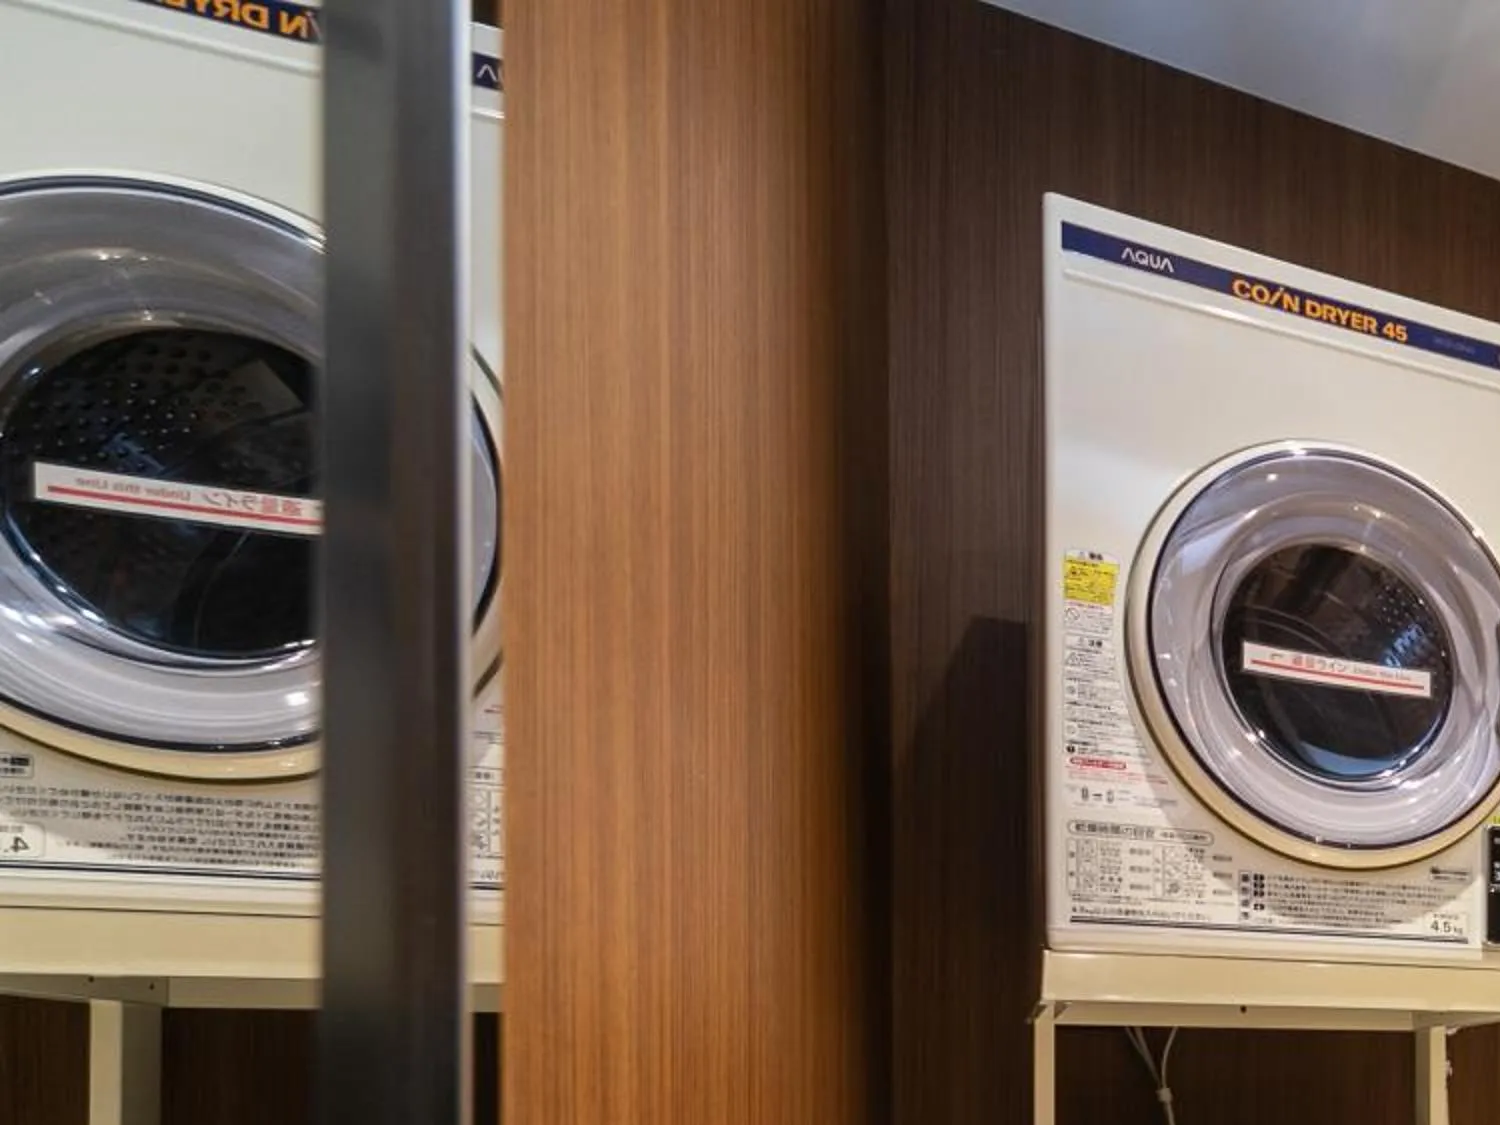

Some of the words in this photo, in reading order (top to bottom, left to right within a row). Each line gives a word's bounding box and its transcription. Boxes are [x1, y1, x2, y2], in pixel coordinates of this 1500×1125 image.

[1121, 246, 1175, 274] AQUA
[1305, 299, 1378, 335] DRYER
[1382, 317, 1408, 342] 45
